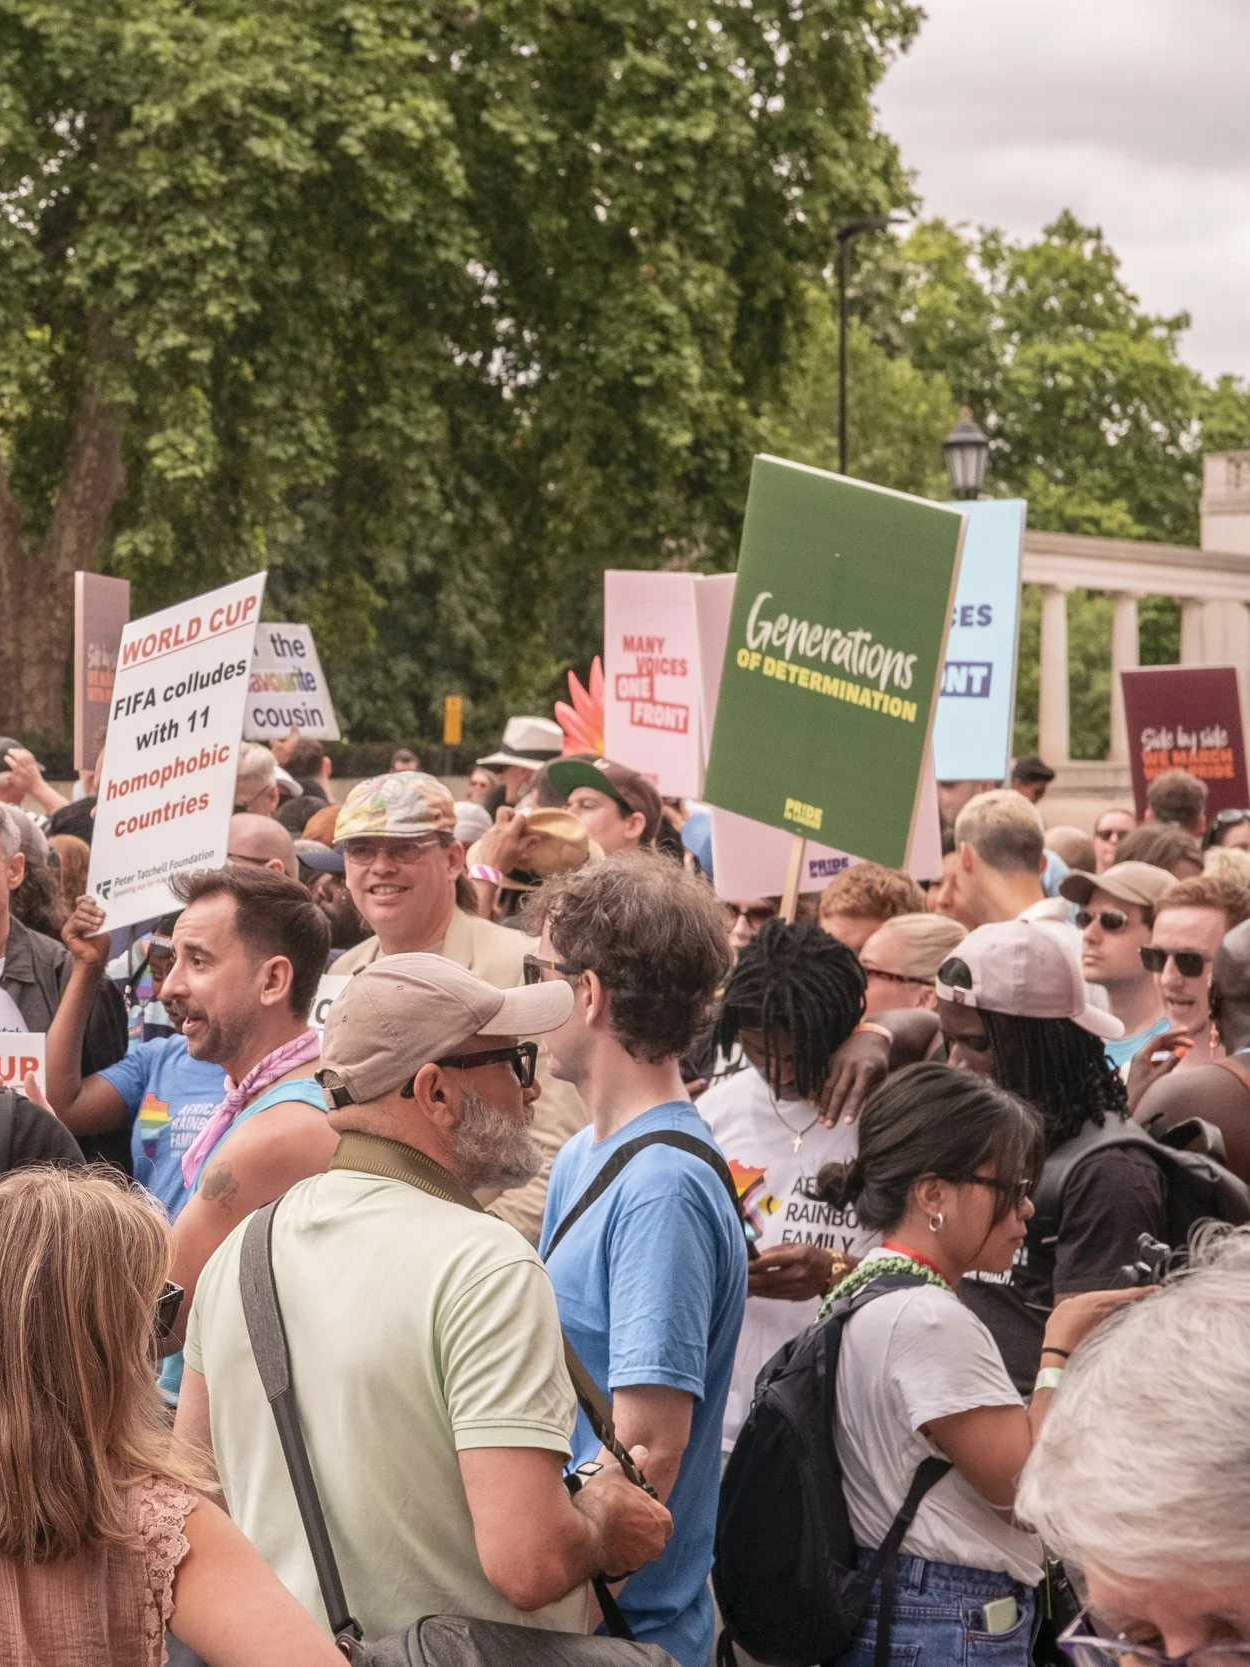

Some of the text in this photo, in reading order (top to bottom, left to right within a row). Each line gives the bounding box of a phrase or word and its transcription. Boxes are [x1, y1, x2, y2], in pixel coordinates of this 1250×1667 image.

[122, 617, 202, 666] WORLD
[209, 595, 257, 633] CUP
[270, 633, 306, 658] the
[623, 634, 664, 652] MANY
[746, 591, 918, 692] Generations
[248, 665, 317, 692] avourite
[636, 656, 688, 677] VOICES
[113, 659, 246, 721] FIFA colludes
[617, 677, 652, 698] ONE
[736, 648, 917, 723] OF DETERMINATION
[136, 705, 210, 751] with 11
[253, 701, 324, 727] cousin
[634, 702, 687, 730] FRONT
[106, 744, 230, 801] homophobic
[114, 793, 209, 837] countries
[114, 874, 135, 887] Peter
[137, 861, 168, 880] Tatchell
[169, 850, 215, 870] Foundation
[786, 1202, 858, 1228] RAINBO
